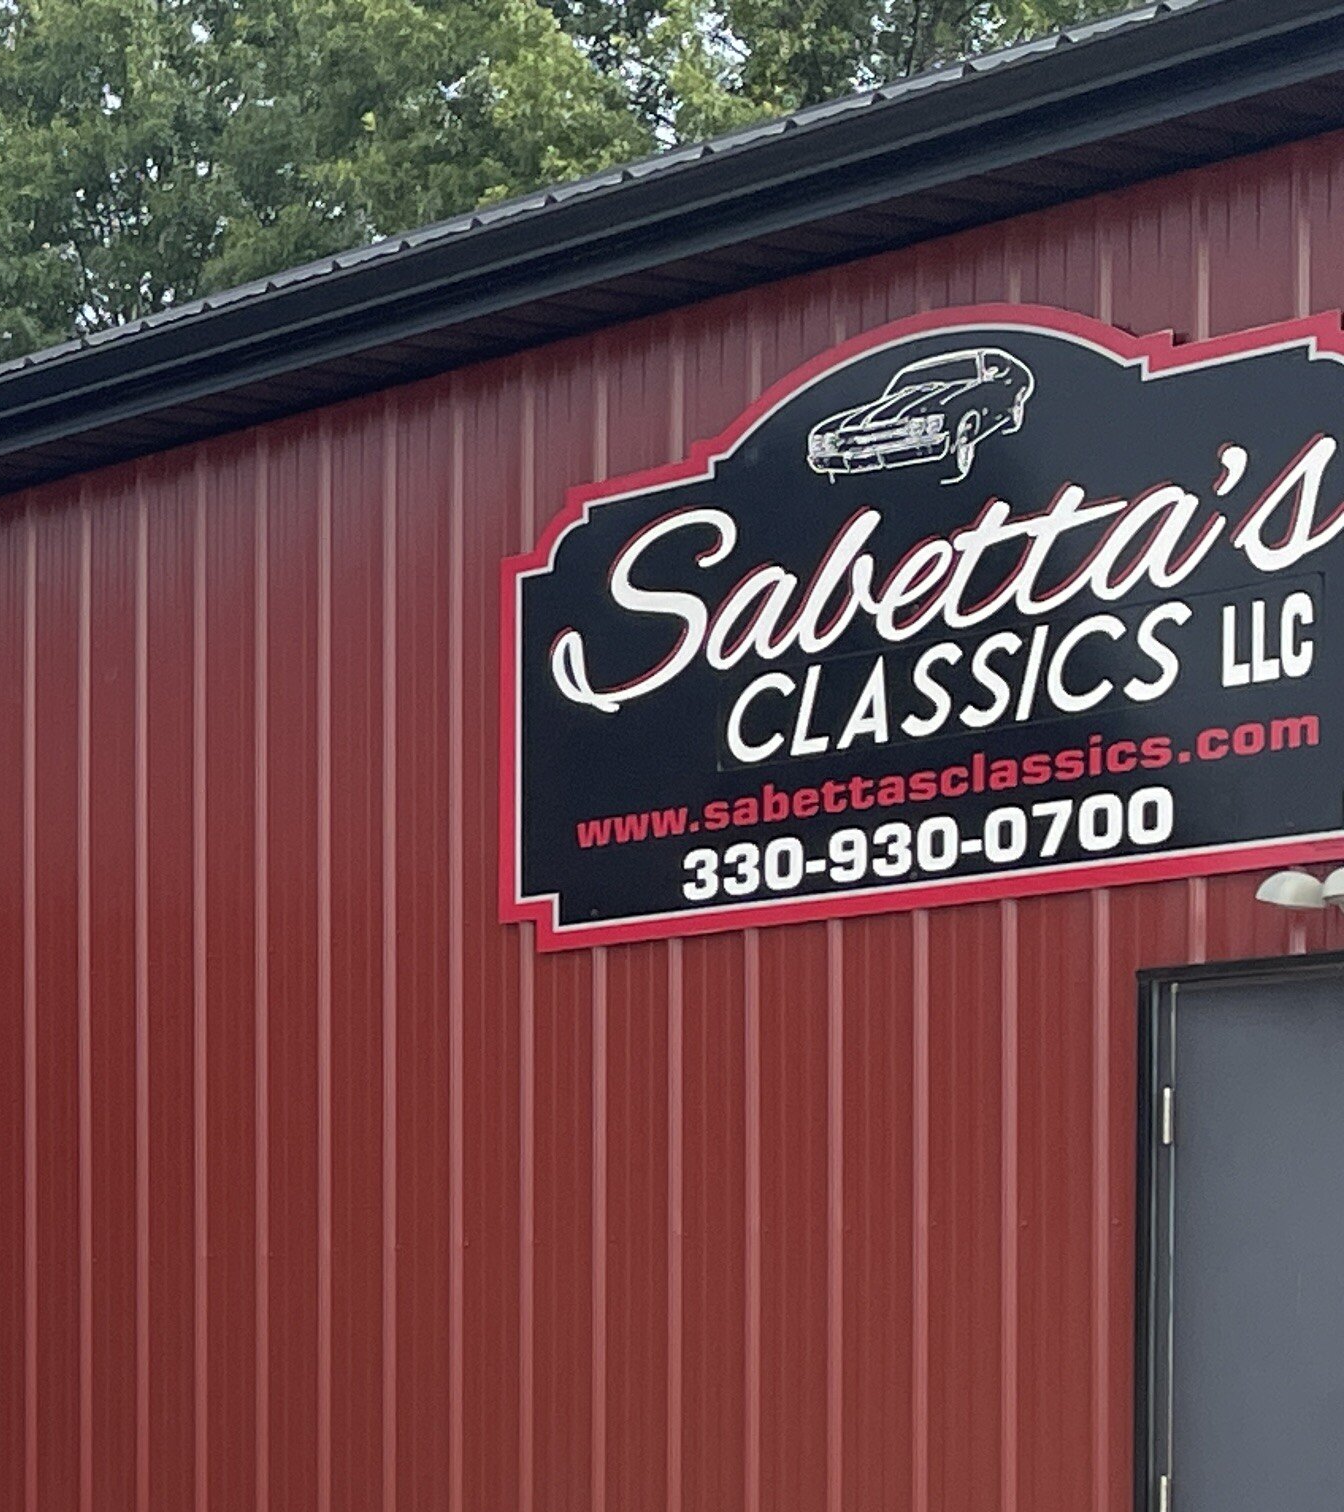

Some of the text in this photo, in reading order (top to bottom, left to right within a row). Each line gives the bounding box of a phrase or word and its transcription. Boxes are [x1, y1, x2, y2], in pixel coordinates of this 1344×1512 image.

[550, 433, 1344, 714] Sabetta's
[726, 590, 1315, 763] CLASSICS LLC
[576, 713, 1320, 850] www.sabettasclassics.com
[681, 786, 1174, 902] 330-930-0700
